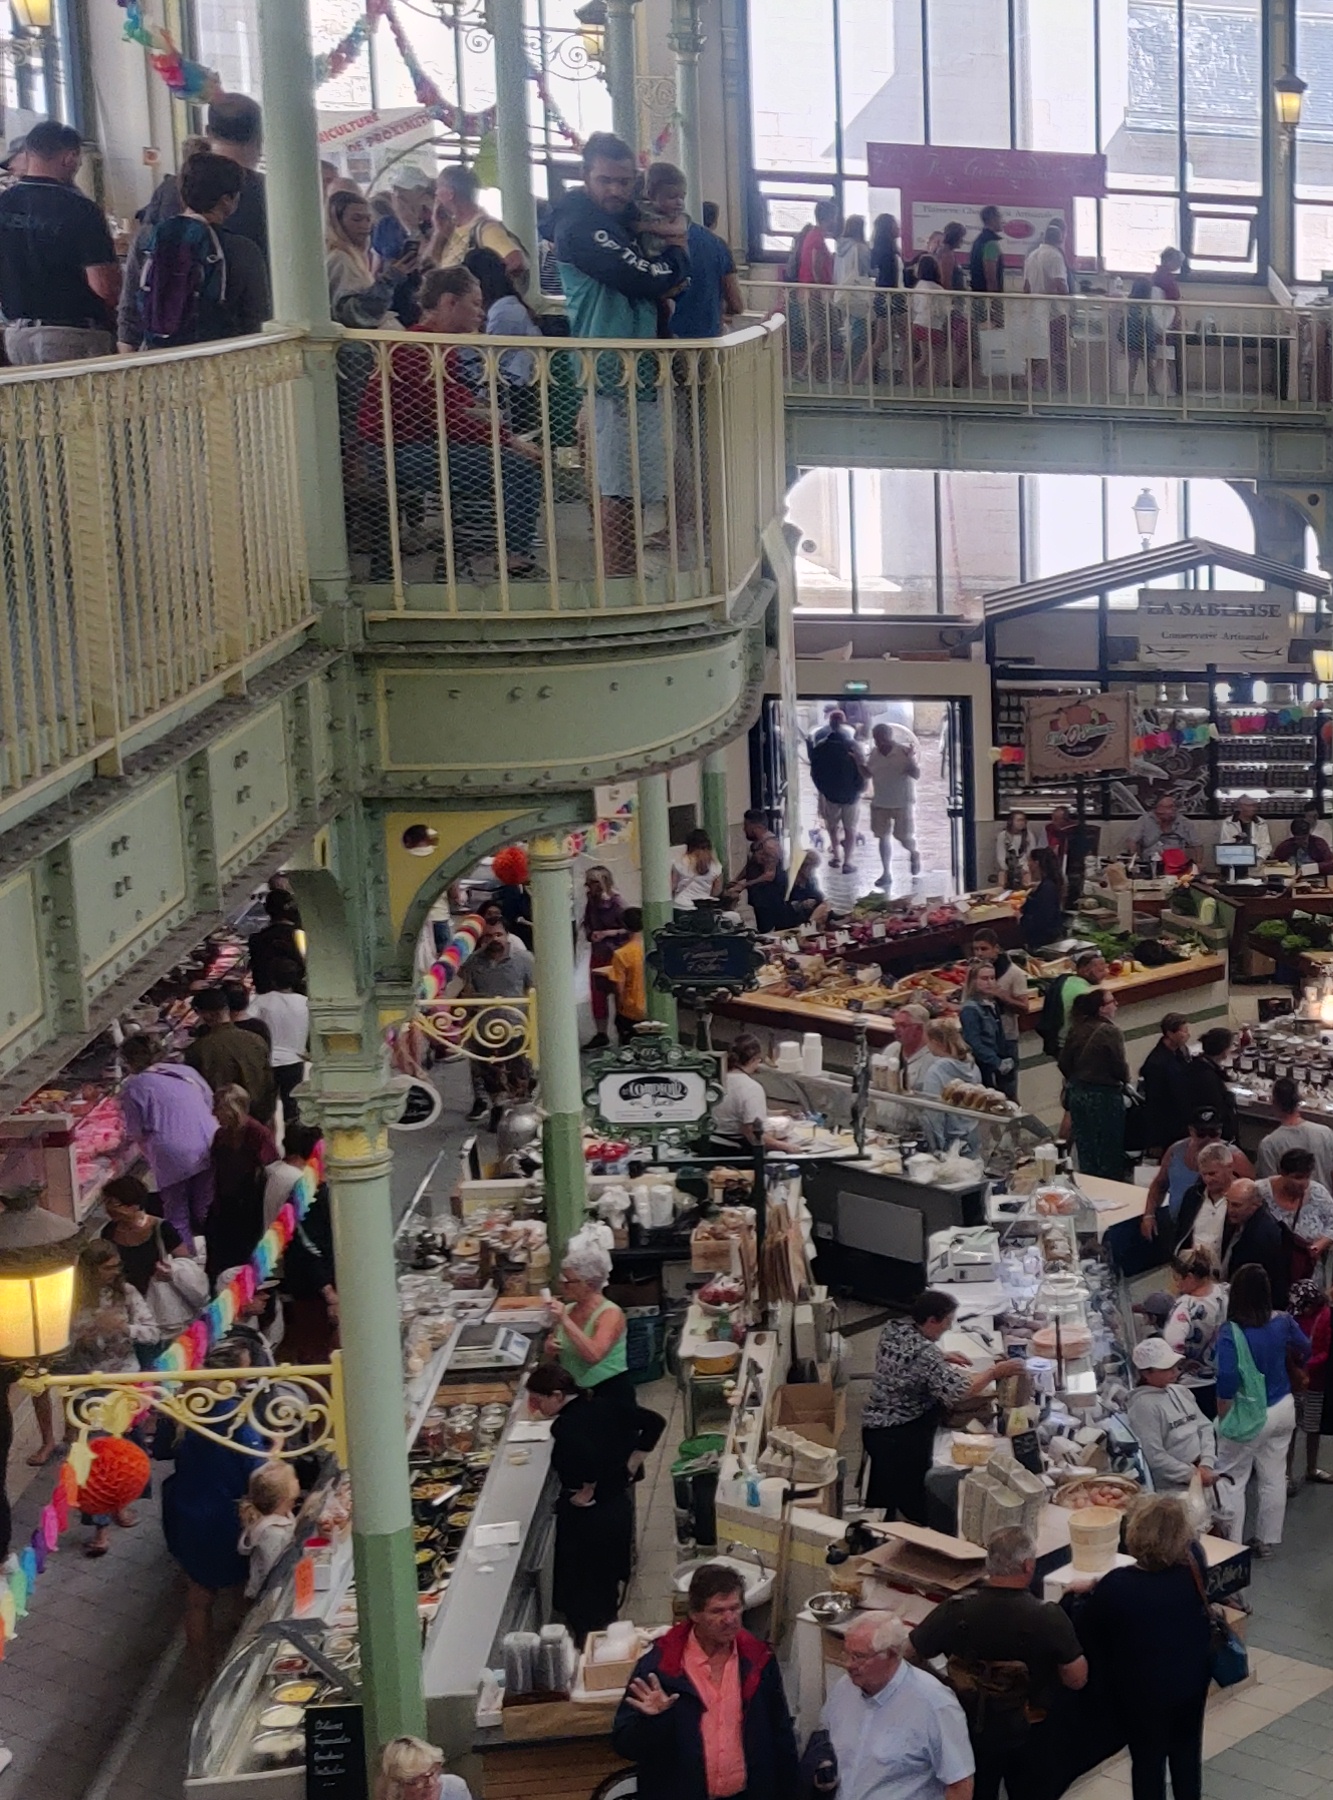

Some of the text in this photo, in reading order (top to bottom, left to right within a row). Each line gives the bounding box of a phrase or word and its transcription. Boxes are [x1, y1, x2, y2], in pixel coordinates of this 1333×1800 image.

[1147, 602, 1282, 617] LA SABLAISE
[1161, 631, 1270, 641] Conserverie Artisanale
